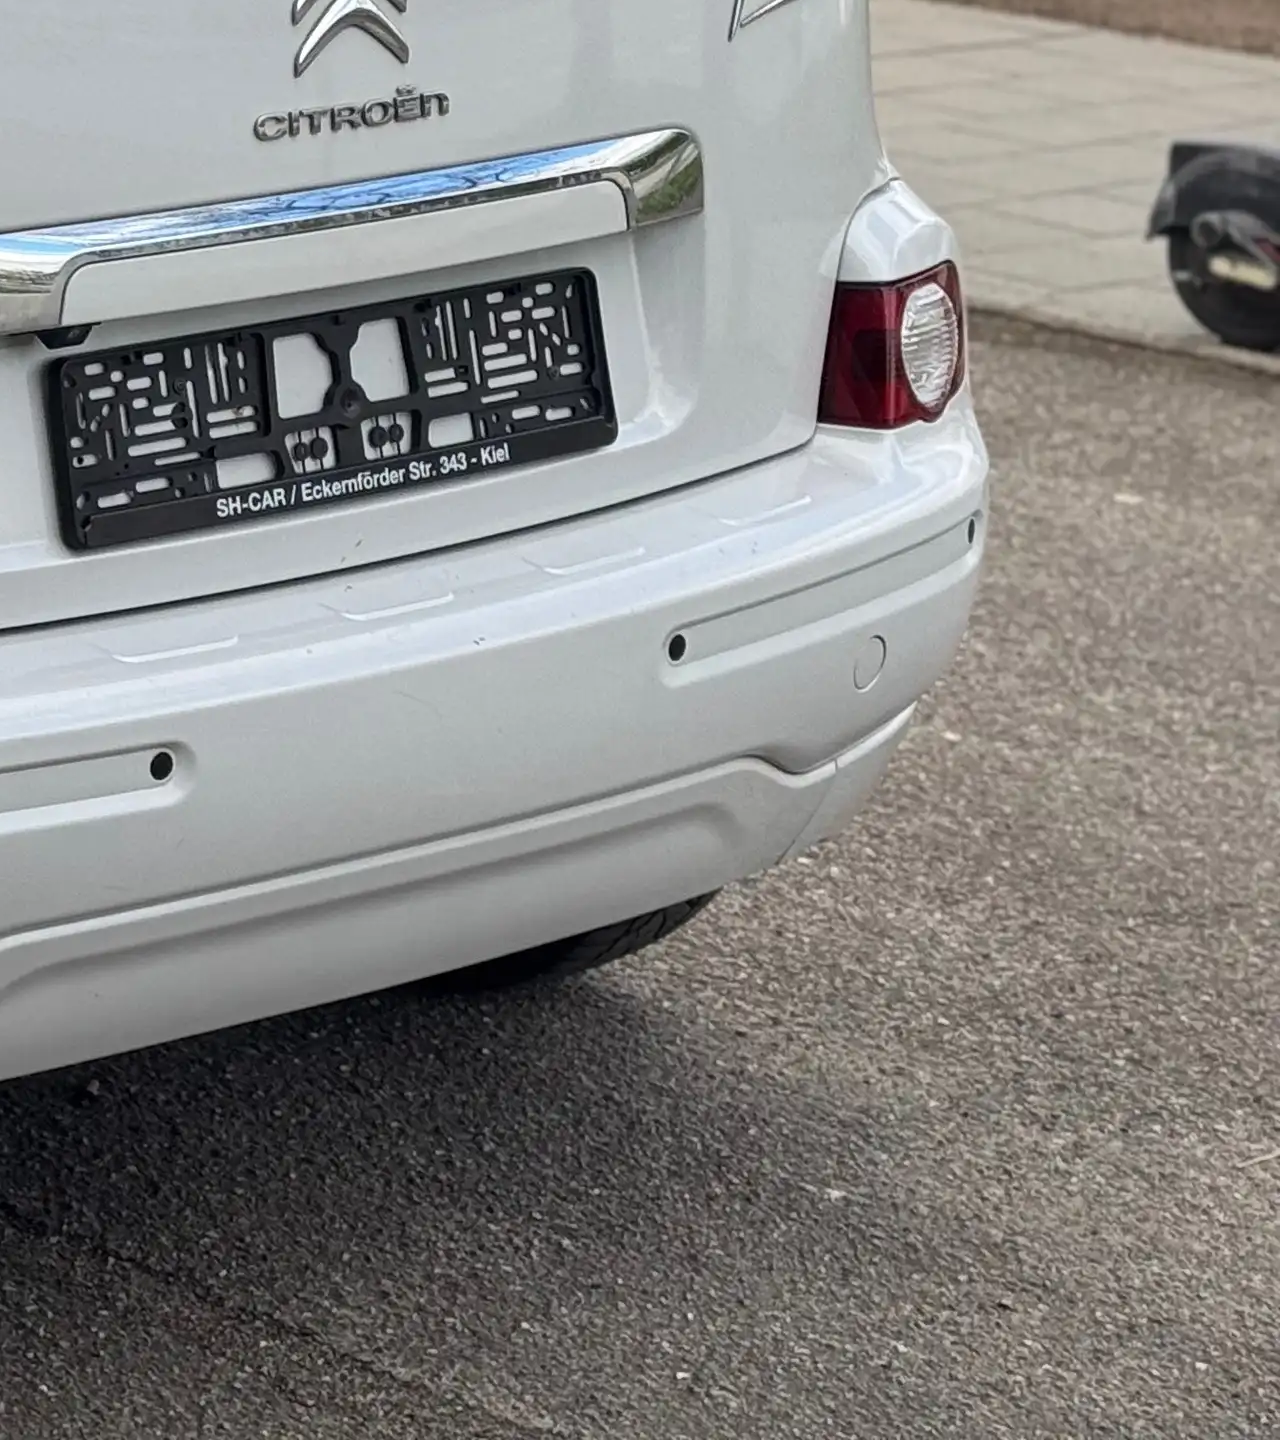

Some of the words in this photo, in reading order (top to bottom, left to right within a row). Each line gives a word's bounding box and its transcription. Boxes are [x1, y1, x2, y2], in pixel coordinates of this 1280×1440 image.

[216, 487, 287, 518] SH-CAR
[301, 465, 407, 503] Eckernförder
[408, 459, 437, 482] Str.
[440, 450, 468, 475] 343
[480, 442, 511, 468] Kiel
